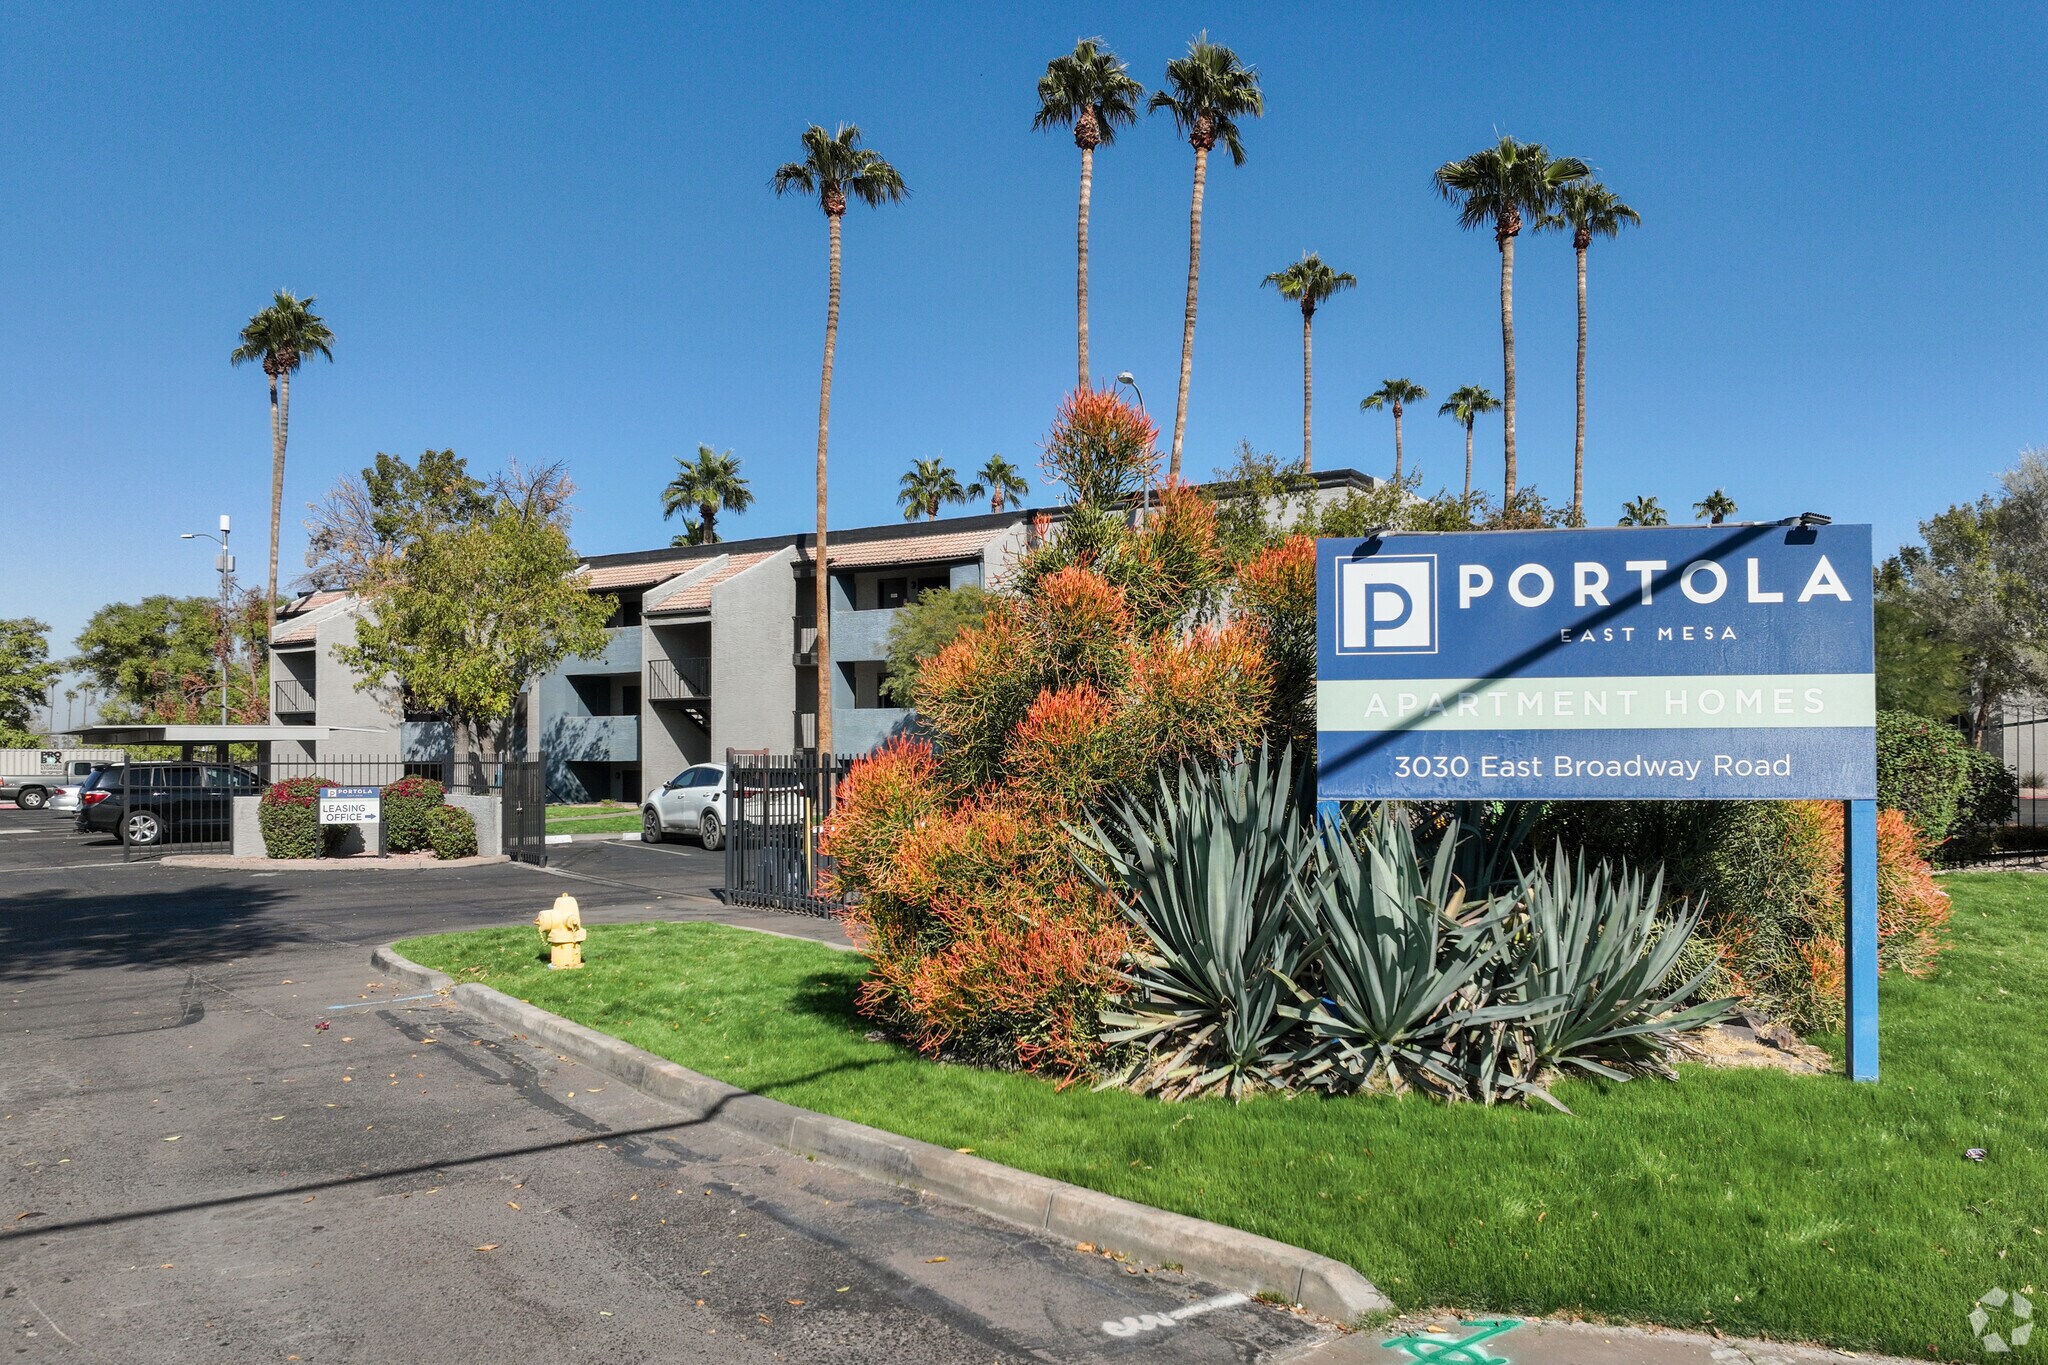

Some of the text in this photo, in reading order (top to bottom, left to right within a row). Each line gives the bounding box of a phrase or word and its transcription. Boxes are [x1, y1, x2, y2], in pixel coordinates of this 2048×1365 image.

[1459, 554, 1853, 609] PORTOLA
[1560, 625, 1737, 643] EAST MESA
[1364, 687, 1825, 718] APARTMENT HOMES
[1395, 753, 1791, 781] 3030 East Broadway Road
